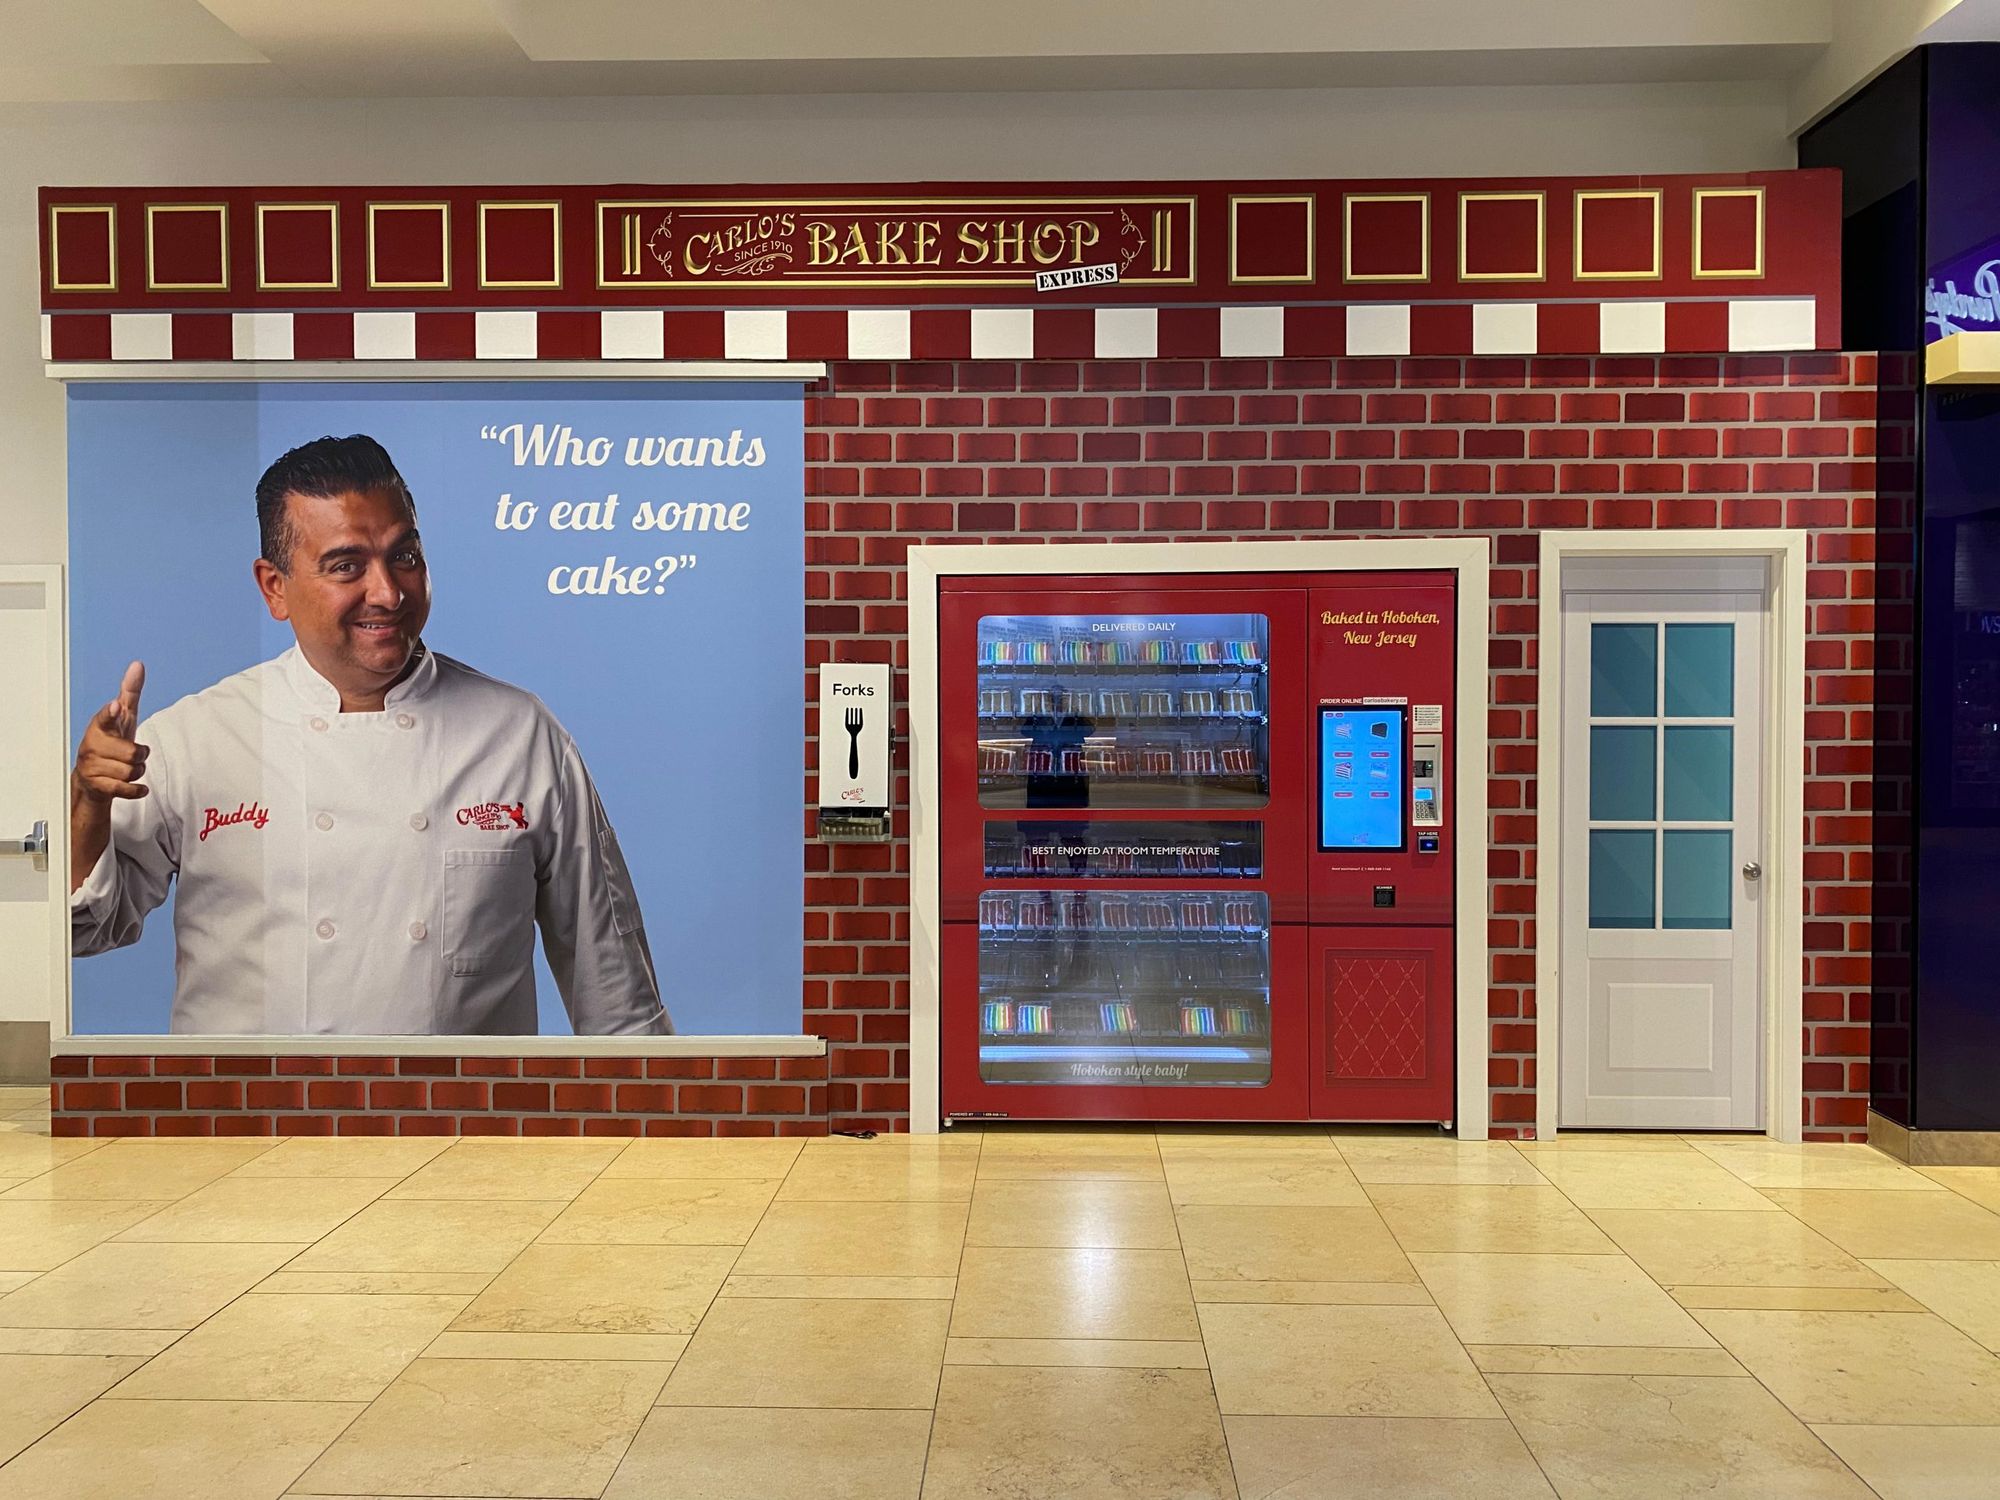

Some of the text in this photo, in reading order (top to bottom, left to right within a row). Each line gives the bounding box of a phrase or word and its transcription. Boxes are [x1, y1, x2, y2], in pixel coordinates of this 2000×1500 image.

[682, 213, 796, 275] CARLO'S
[733, 241, 794, 262] SINCE 1910
[805, 220, 1101, 267] BAKE SHOP
[1038, 266, 1116, 290] EXPRESS
[624, 428, 767, 467] wants
[494, 493, 751, 532] to eat some
[1092, 622, 1176, 632] DELIVERED DAILY
[1320, 610, 1440, 626] Baked in Hoboken,
[1343, 631, 1418, 648] New Jersey
[833, 683, 875, 697] Forks
[1319, 697, 1341, 705] ORDER
[1341, 697, 1362, 705] ONLINE
[199, 801, 269, 842] Buddy
[456, 802, 500, 825] CARLO'S
[1032, 846, 1220, 857] BEST ENJOYED AT ROOM TEMPERATURE
[1070, 1063, 1189, 1079] Hoboken style baby!
